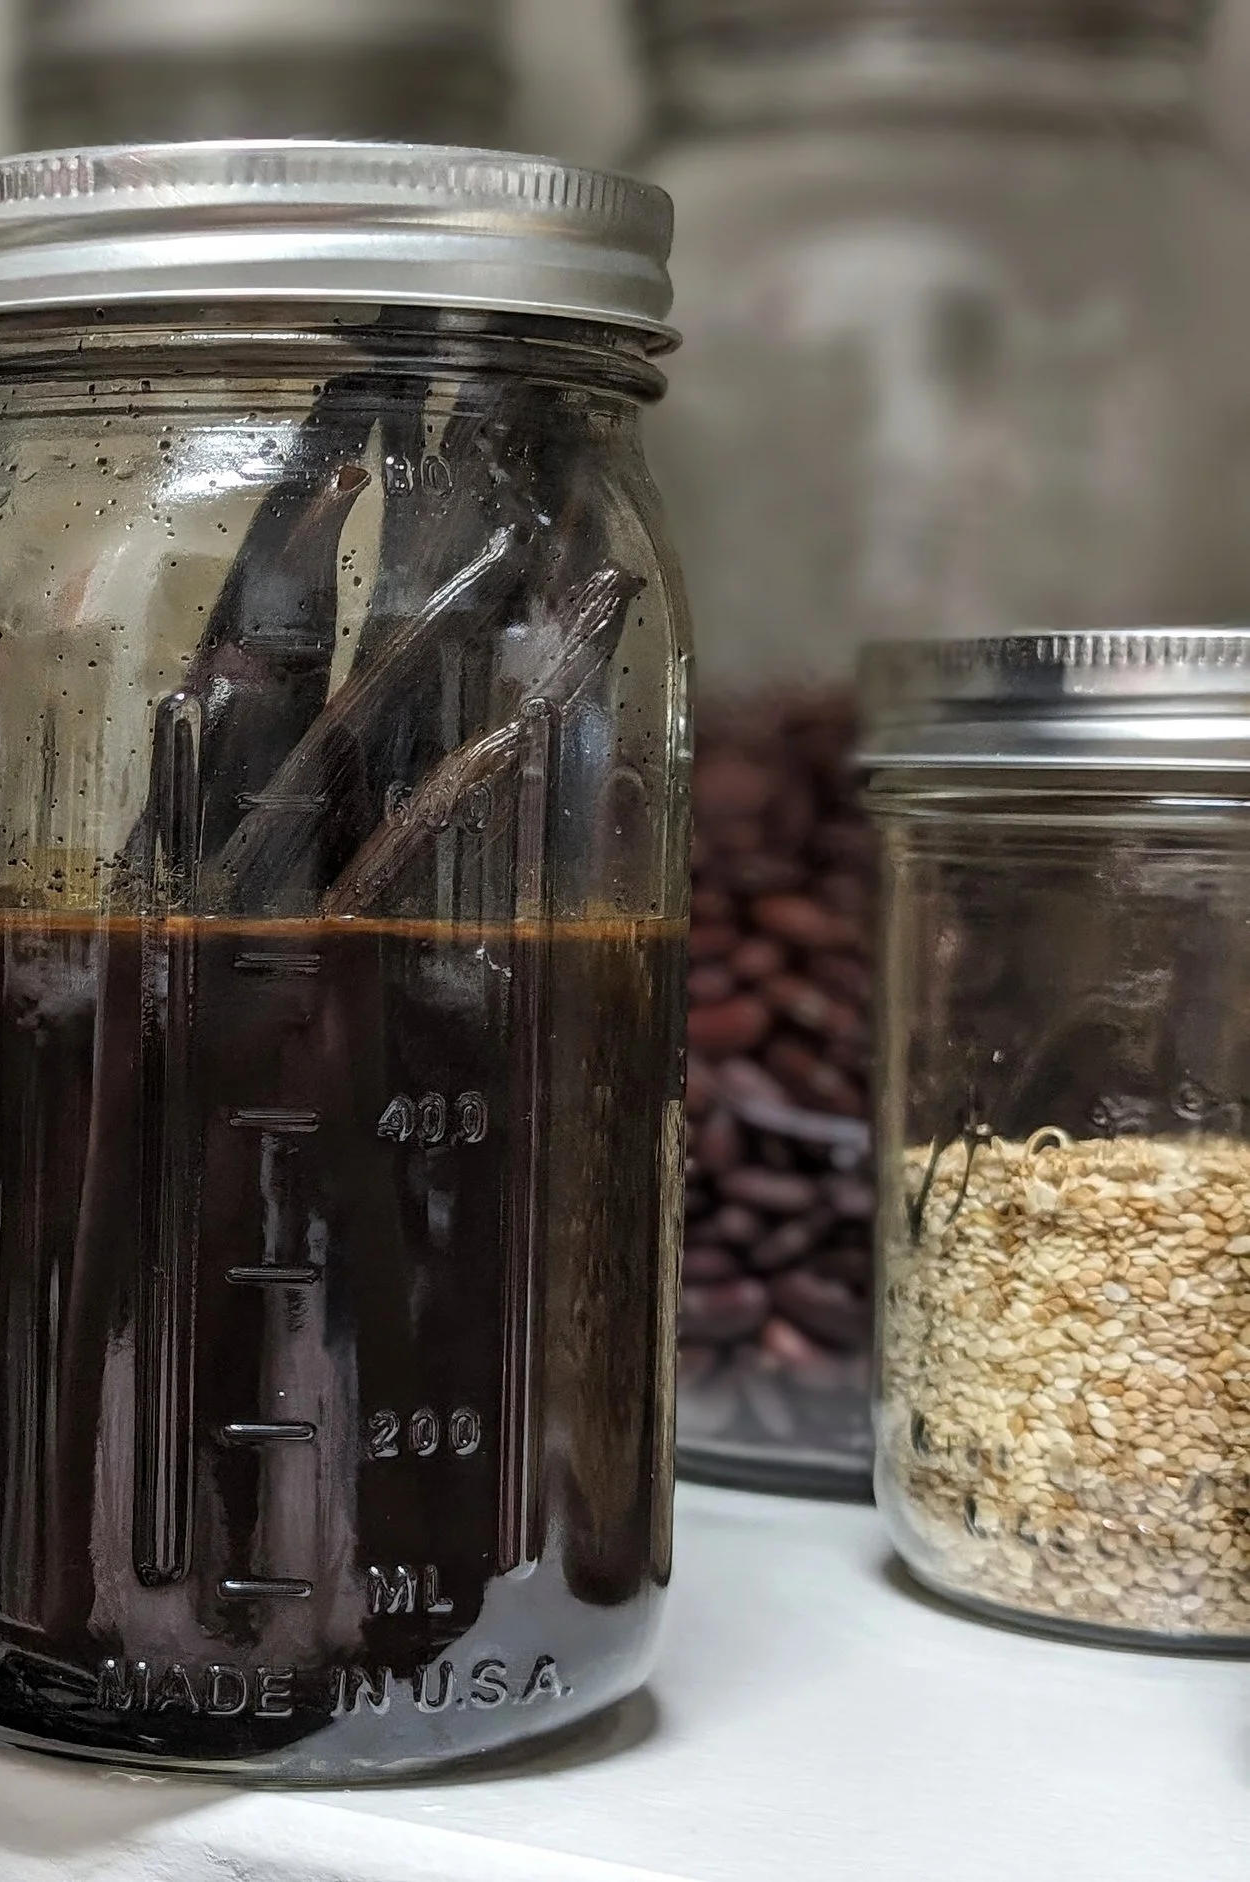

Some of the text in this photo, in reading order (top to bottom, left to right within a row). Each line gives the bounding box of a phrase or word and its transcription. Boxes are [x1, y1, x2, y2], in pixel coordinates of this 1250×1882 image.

[377, 1090, 488, 1144] 400
[367, 1408, 482, 1458] 200
[366, 1563, 454, 1615] ML
[97, 1658, 296, 1718] MADE
[330, 1662, 394, 1719] IN
